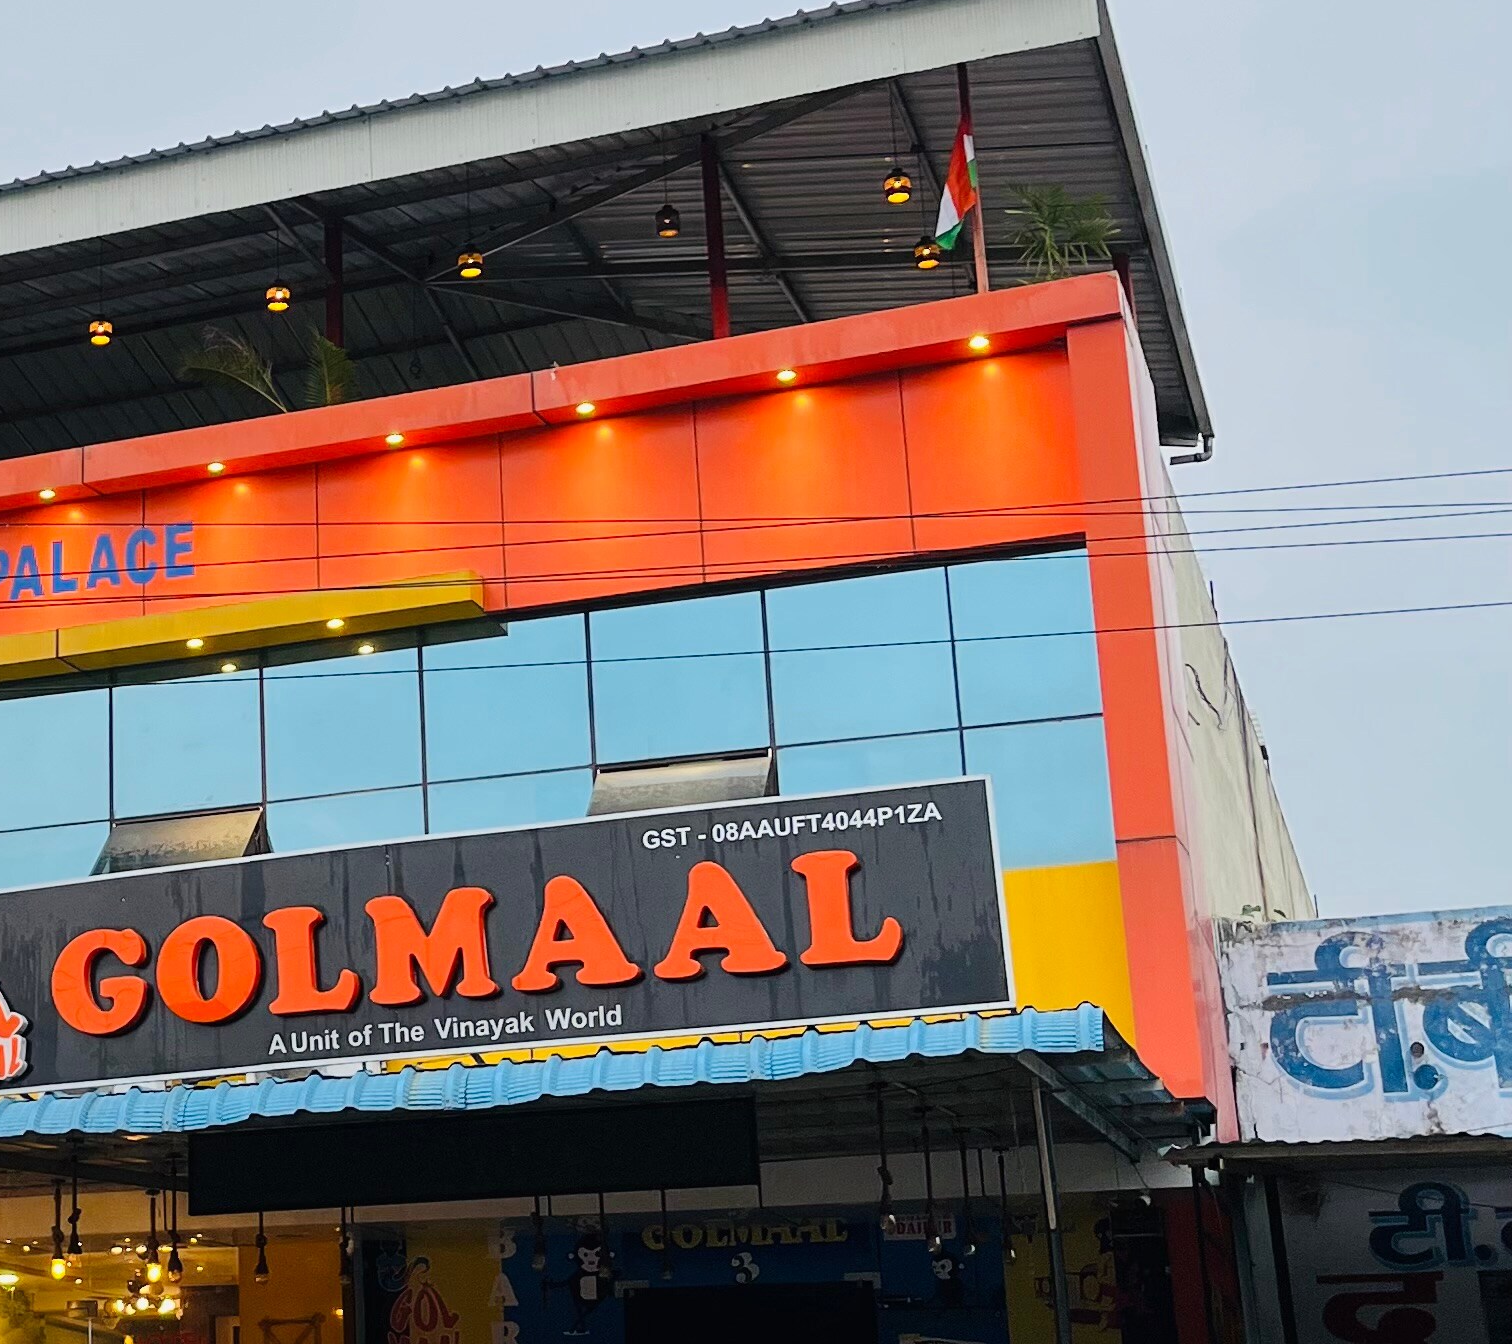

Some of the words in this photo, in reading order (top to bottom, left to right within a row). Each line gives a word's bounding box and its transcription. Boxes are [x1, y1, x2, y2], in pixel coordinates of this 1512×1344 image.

[642, 827, 692, 851] GST
[711, 802, 943, 845] 08AAUFT4044P1ZA
[51, 849, 904, 1036] GOLMAAL
[267, 1032, 288, 1056] A
[290, 1027, 340, 1054] Unit
[347, 1024, 374, 1049] of
[379, 1020, 425, 1046] The
[433, 1011, 535, 1044] Vinayak
[544, 1003, 623, 1031] World
[389, 1284, 460, 1333] GOL
